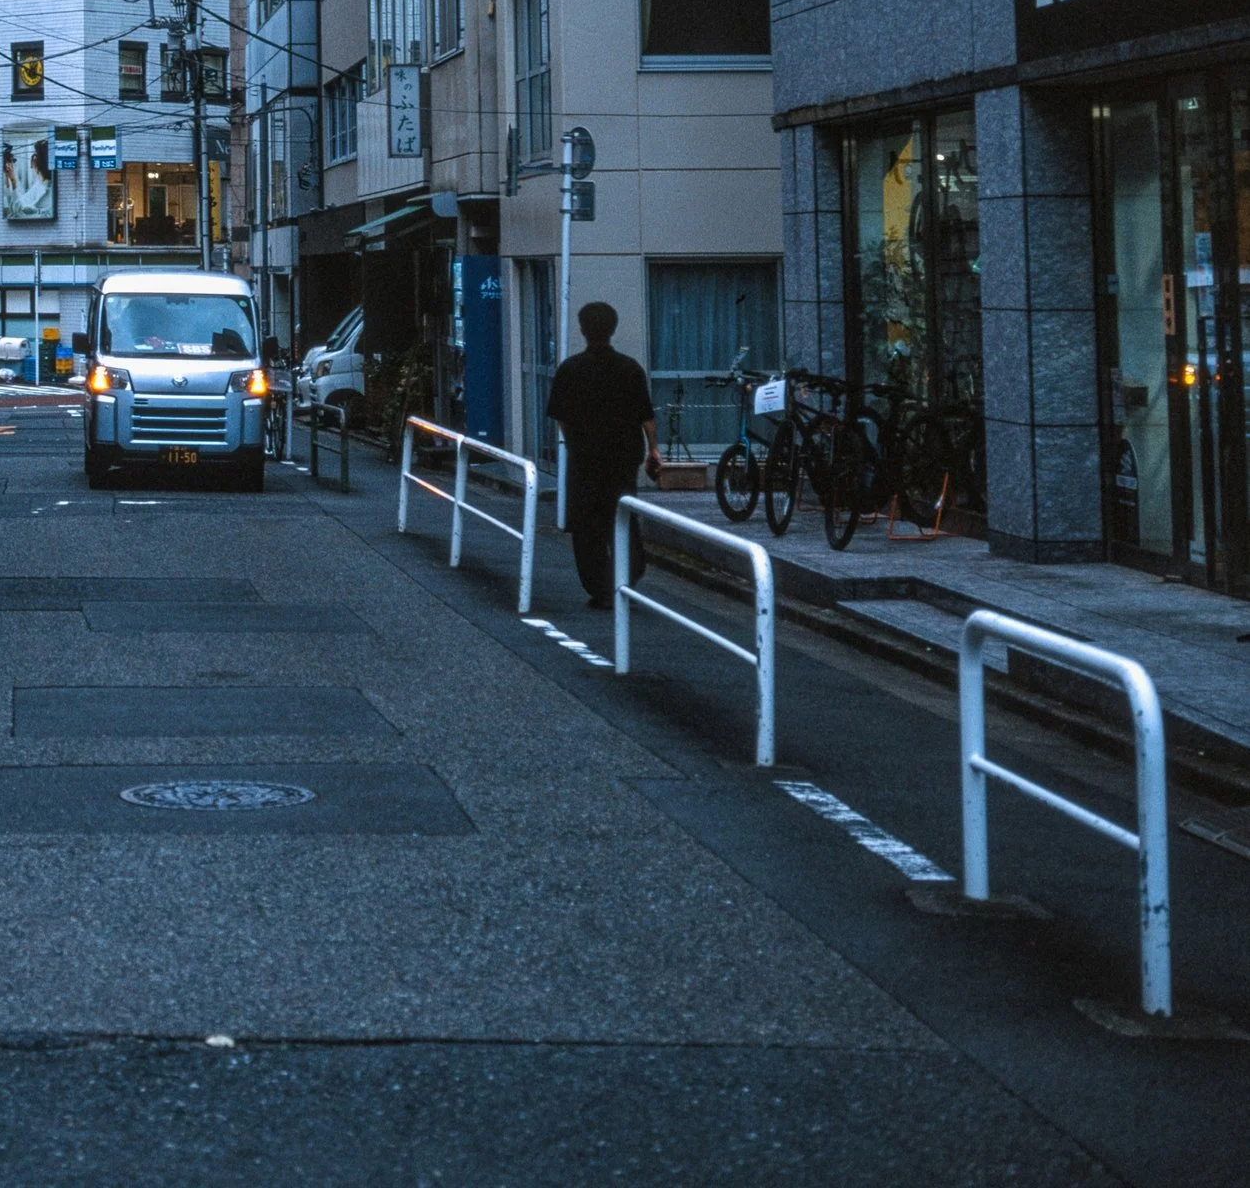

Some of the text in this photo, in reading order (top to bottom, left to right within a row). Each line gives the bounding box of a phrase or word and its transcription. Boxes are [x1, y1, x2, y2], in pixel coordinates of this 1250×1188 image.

[394, 69, 416, 154] 味のふたば
[168, 451, 198, 464] 11-50
